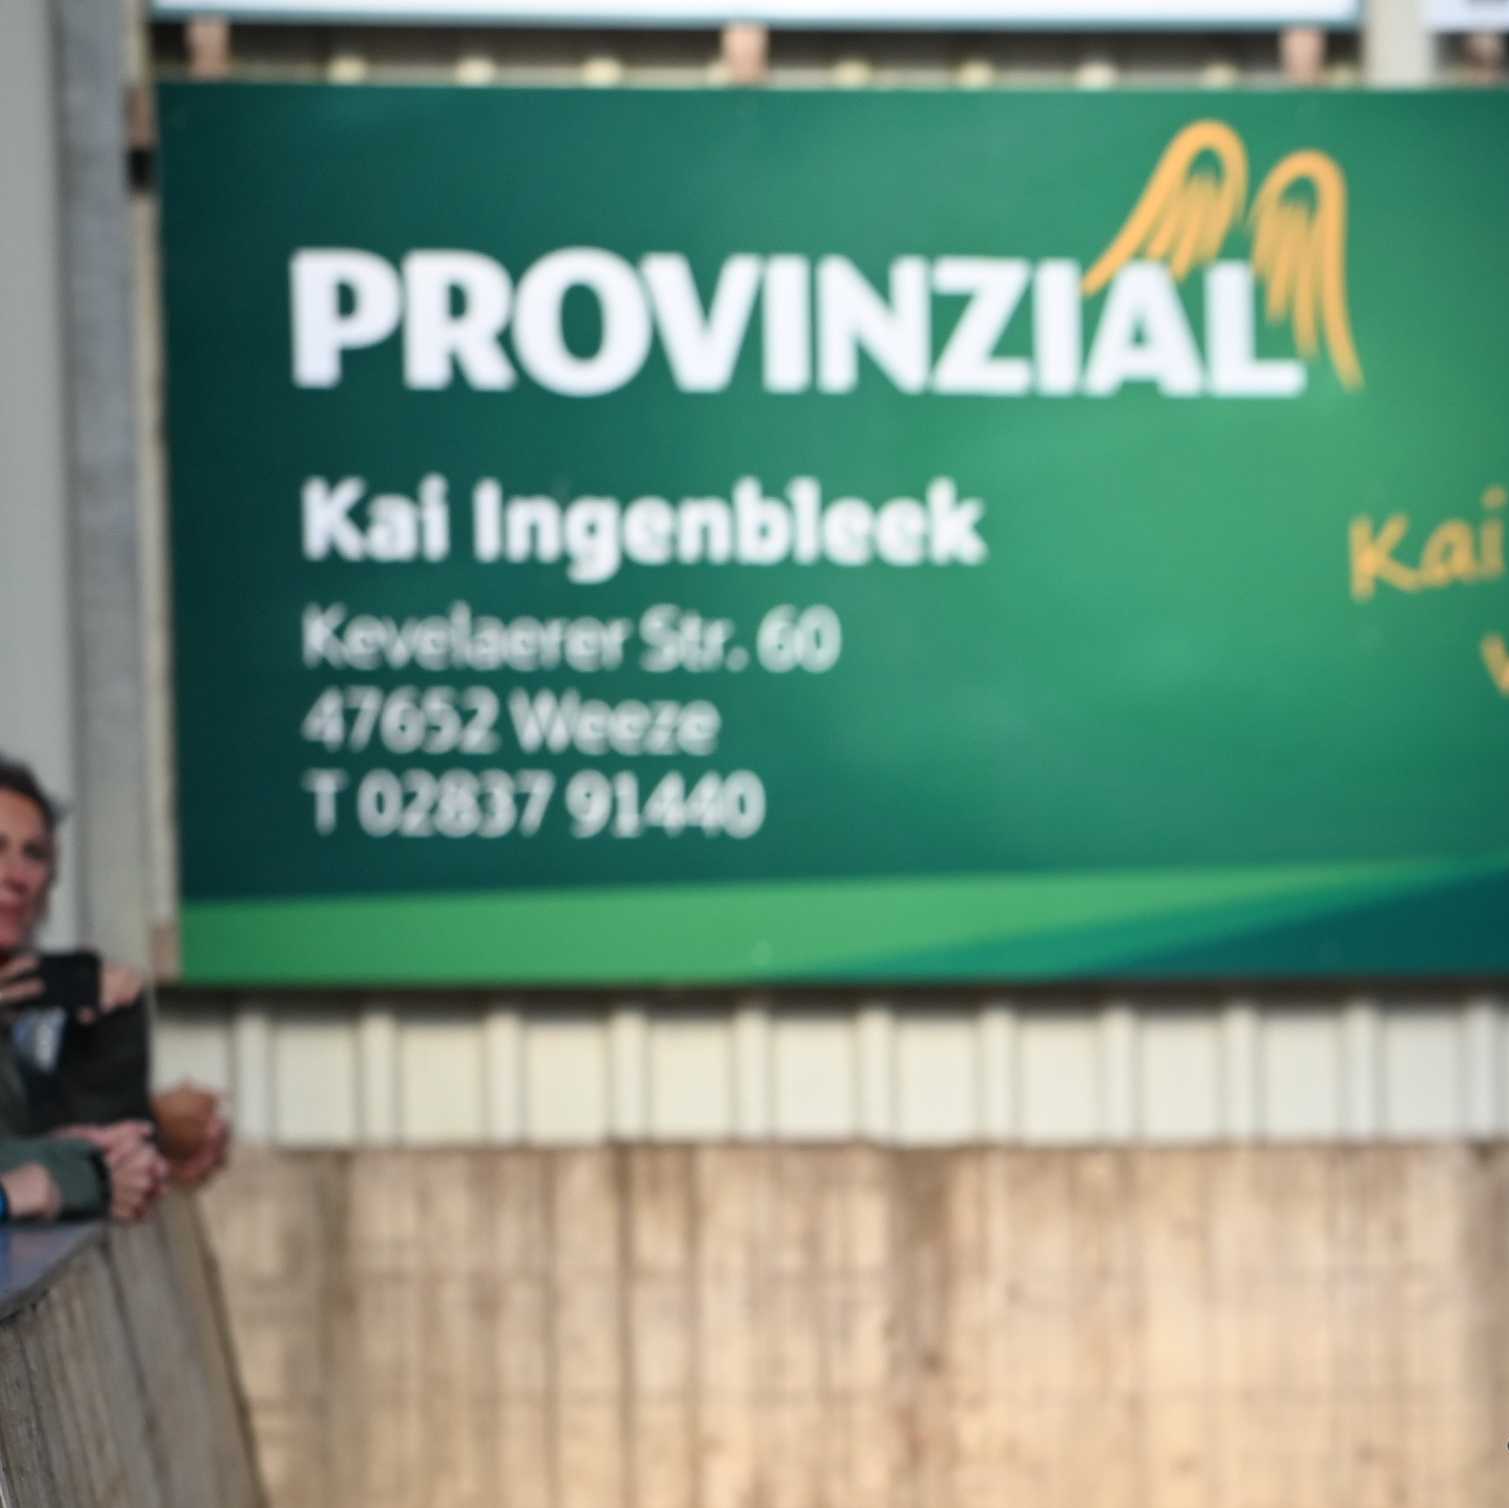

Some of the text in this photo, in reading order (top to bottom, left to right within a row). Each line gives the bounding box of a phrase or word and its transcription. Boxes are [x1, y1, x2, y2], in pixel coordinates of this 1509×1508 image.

[290, 246, 1307, 396] PROVINZIAL
[301, 474, 988, 584] Kai Ingenbleek
[1350, 489, 1508, 600] Kai
[301, 601, 843, 673] Kevelaerer Str. 60
[302, 686, 721, 756] 47652 Weeze
[303, 769, 767, 839] T 02837 91440
